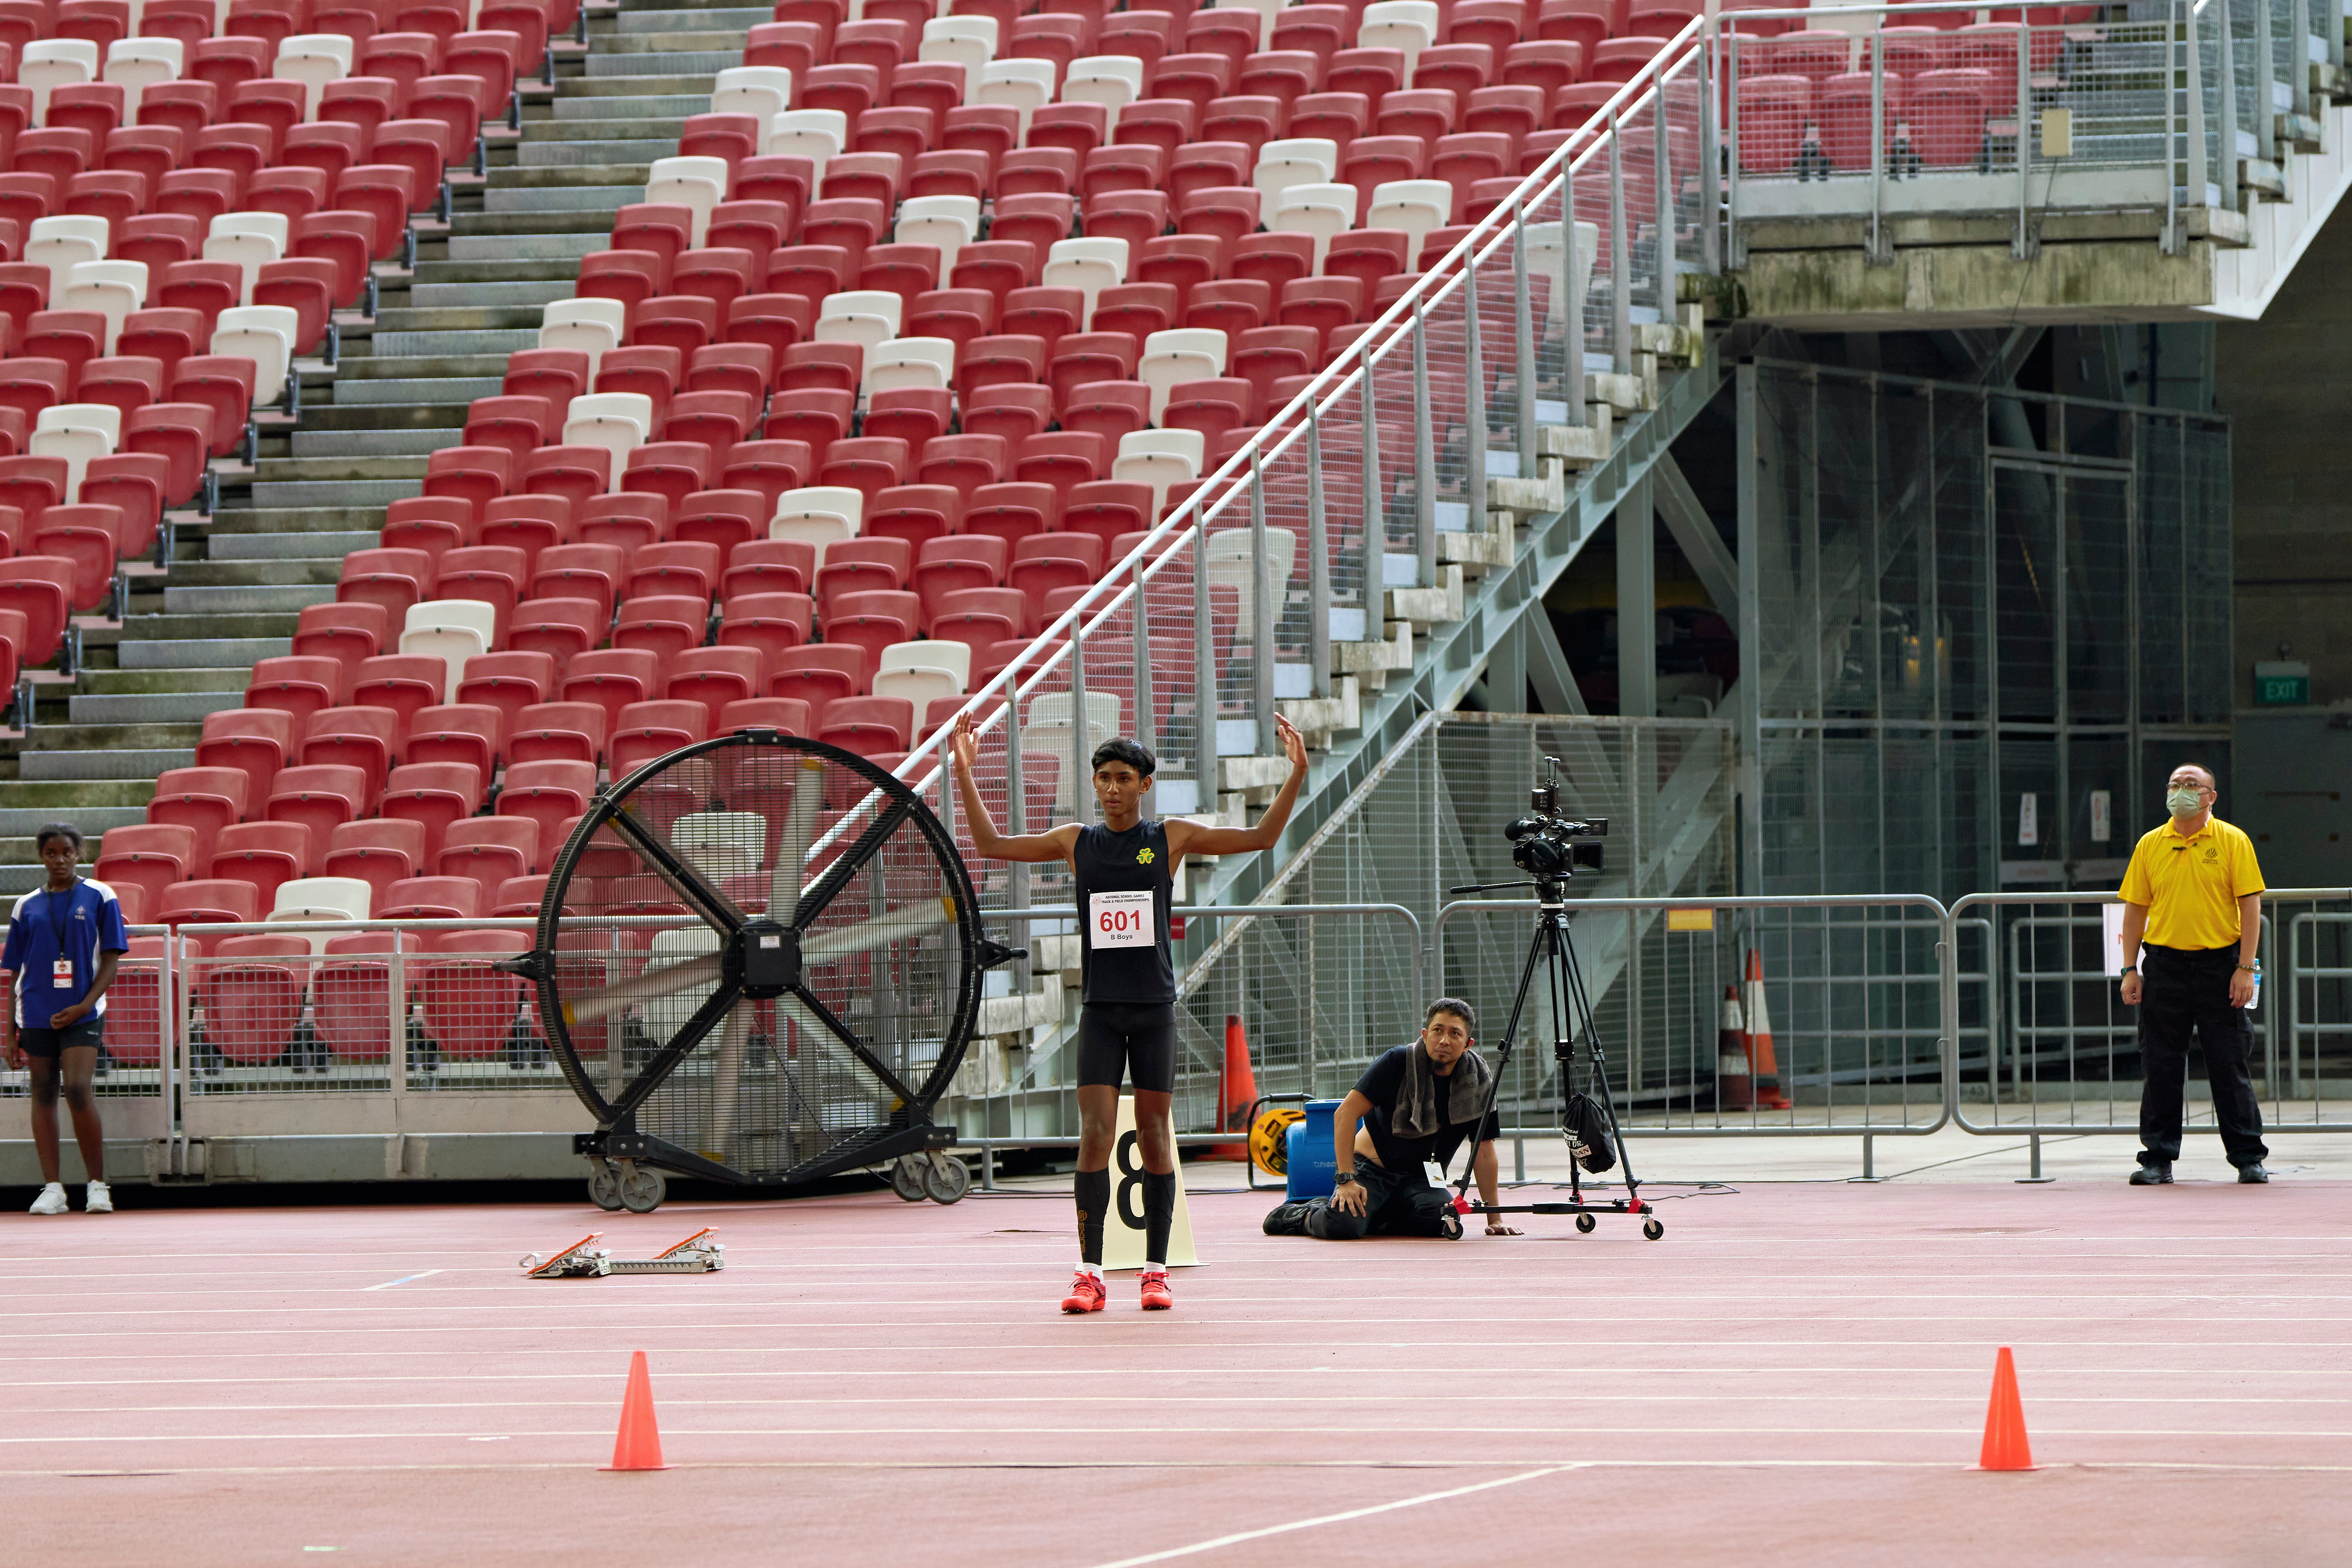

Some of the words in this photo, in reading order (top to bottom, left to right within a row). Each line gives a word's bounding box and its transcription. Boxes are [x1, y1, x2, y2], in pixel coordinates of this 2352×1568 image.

[2266, 681, 2298, 700] EXIT
[1100, 910, 1140, 932] 601
[1116, 1129, 1146, 1230] 8
